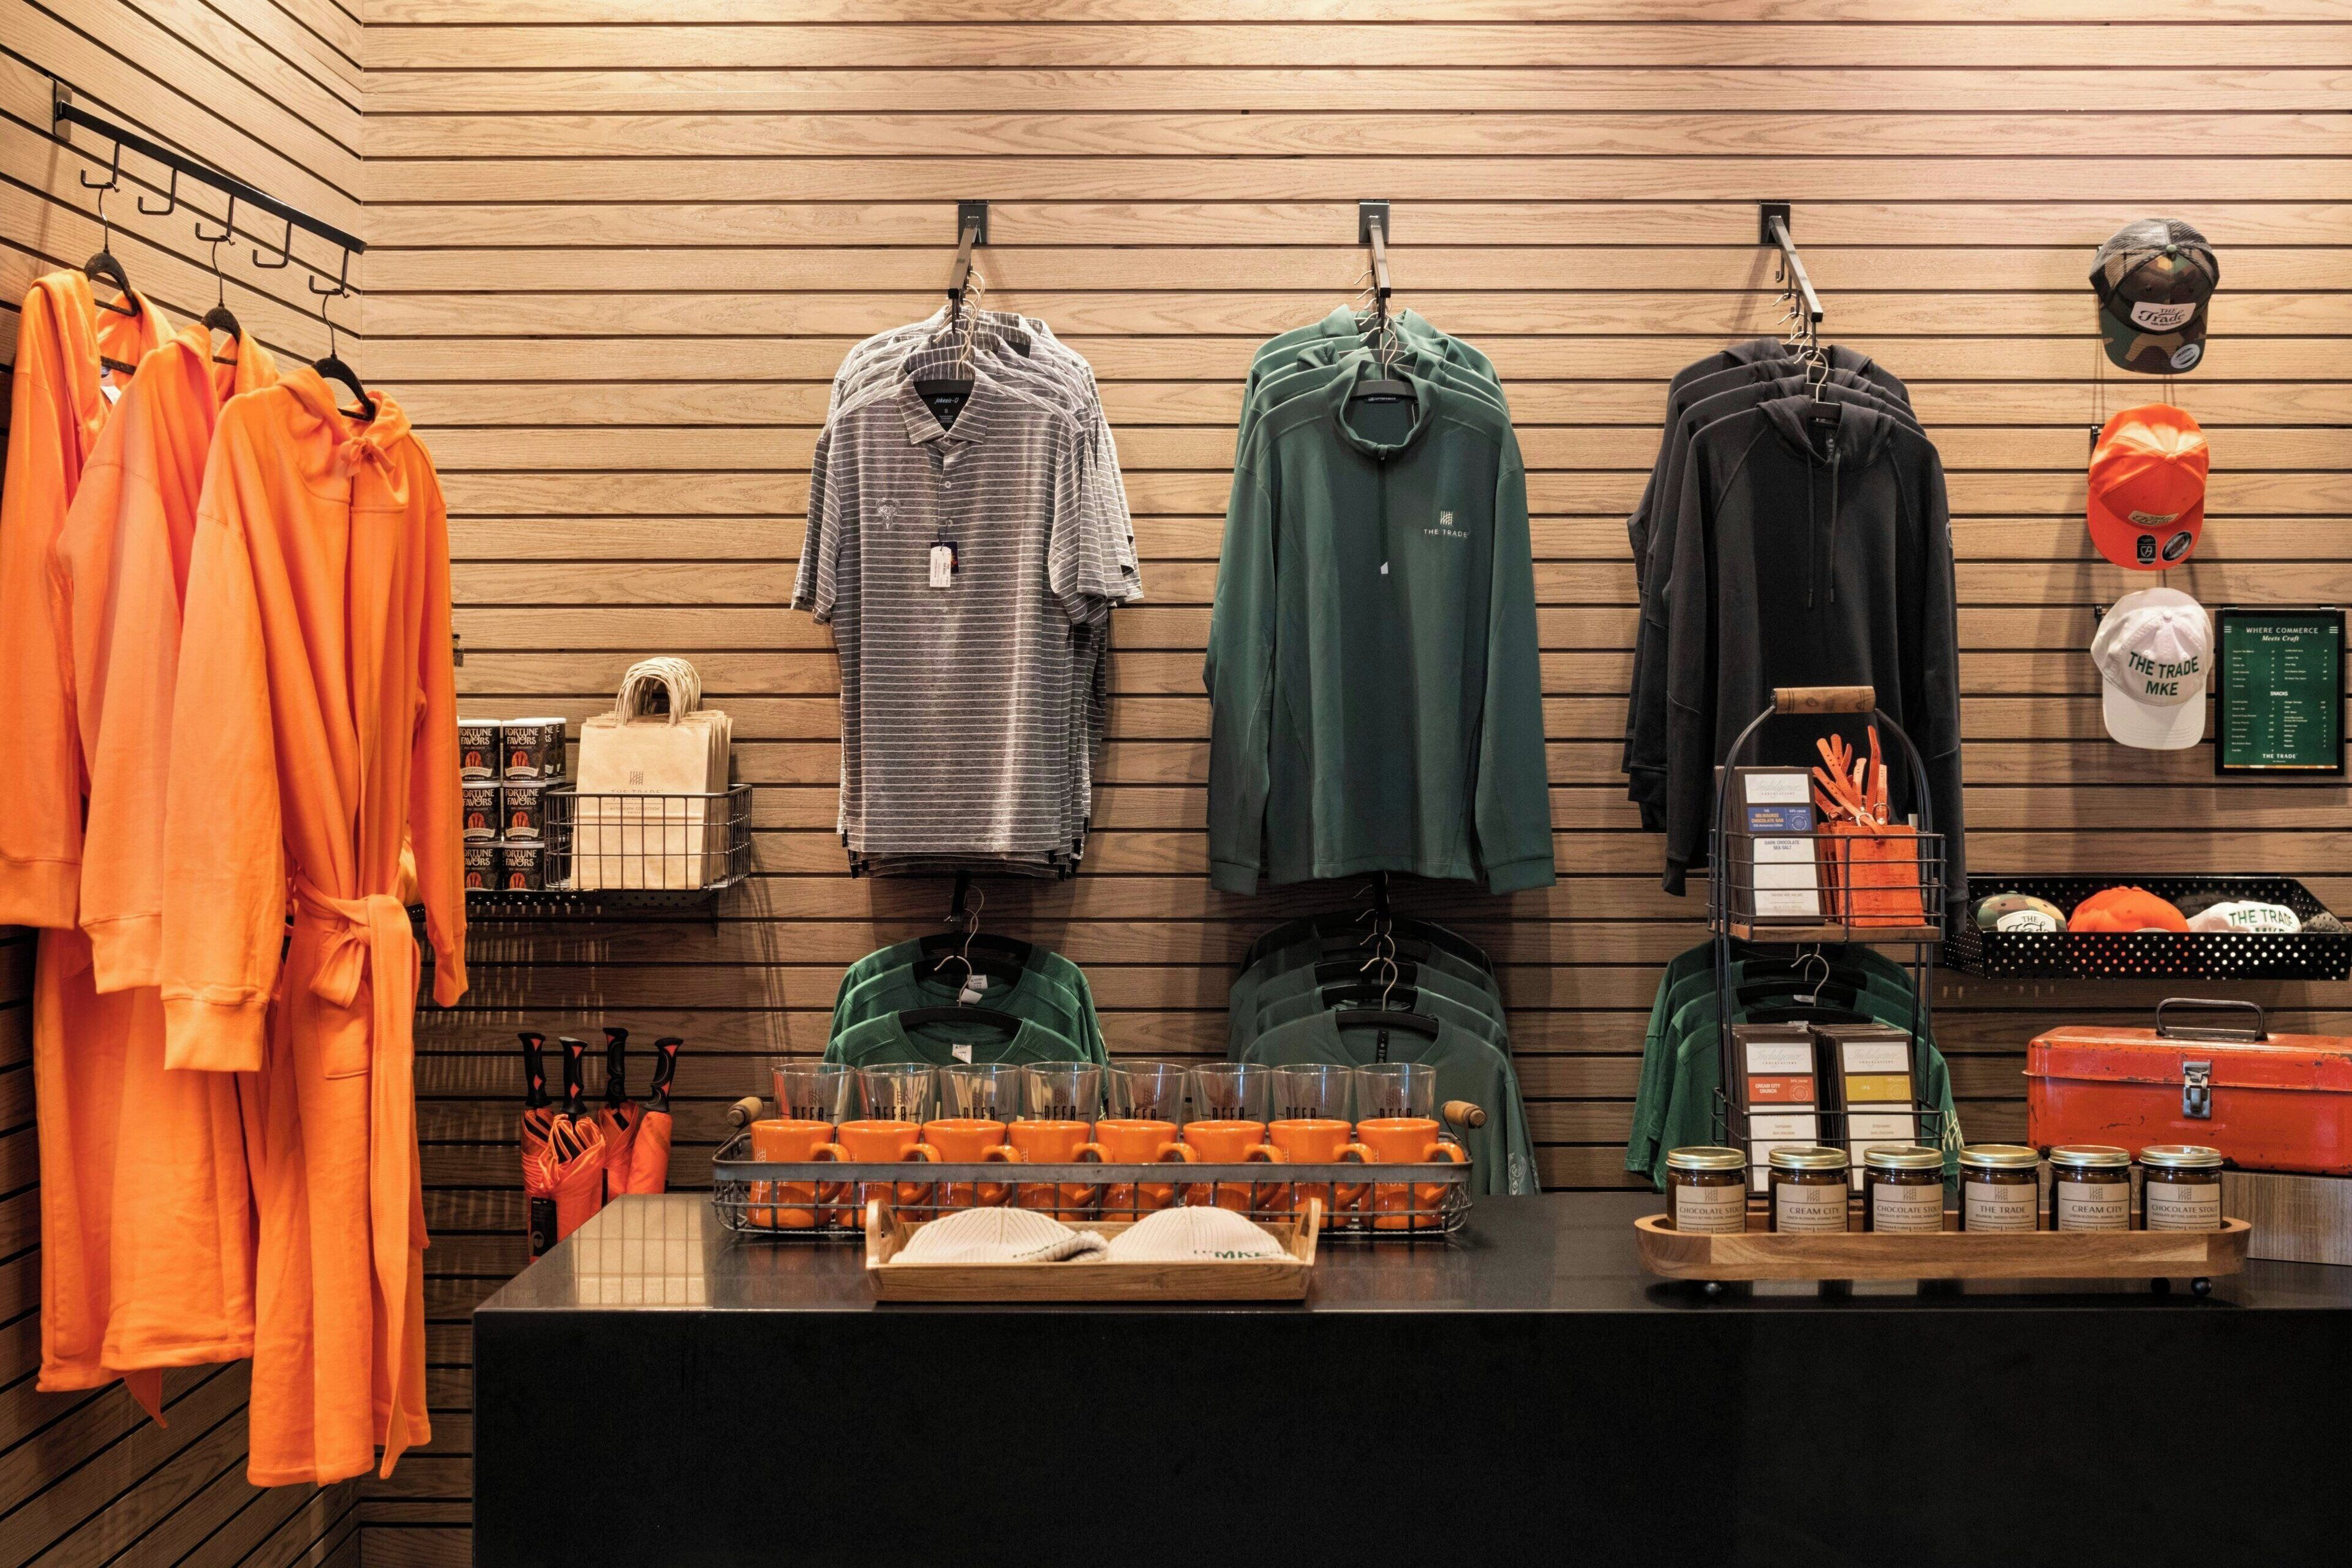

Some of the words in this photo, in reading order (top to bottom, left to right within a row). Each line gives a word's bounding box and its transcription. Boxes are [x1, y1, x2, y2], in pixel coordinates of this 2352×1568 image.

[2138, 309, 2185, 323] Trade
[1442, 529, 1468, 538] TRADE
[2128, 652, 2155, 676] THE
[2158, 656, 2199, 679] TRADE
[2146, 680, 2179, 696] MKE
[505, 728, 539, 736] FORTUNE
[461, 736, 490, 745] FAVORS
[507, 736, 537, 745] FAVORS
[505, 788, 539, 797] FORTUNE
[507, 797, 537, 805] FAVORS
[505, 850, 537, 858] FORTUNE
[464, 858, 490, 866] AVORS
[505, 858, 534, 867] FAVORS
[2228, 910, 2257, 927] THE
[1679, 1206, 1722, 1215] CHOCOLATE
[1877, 1205, 1921, 1213] CHOCOLATE
[2151, 1204, 2198, 1213] CHOCOLATE
